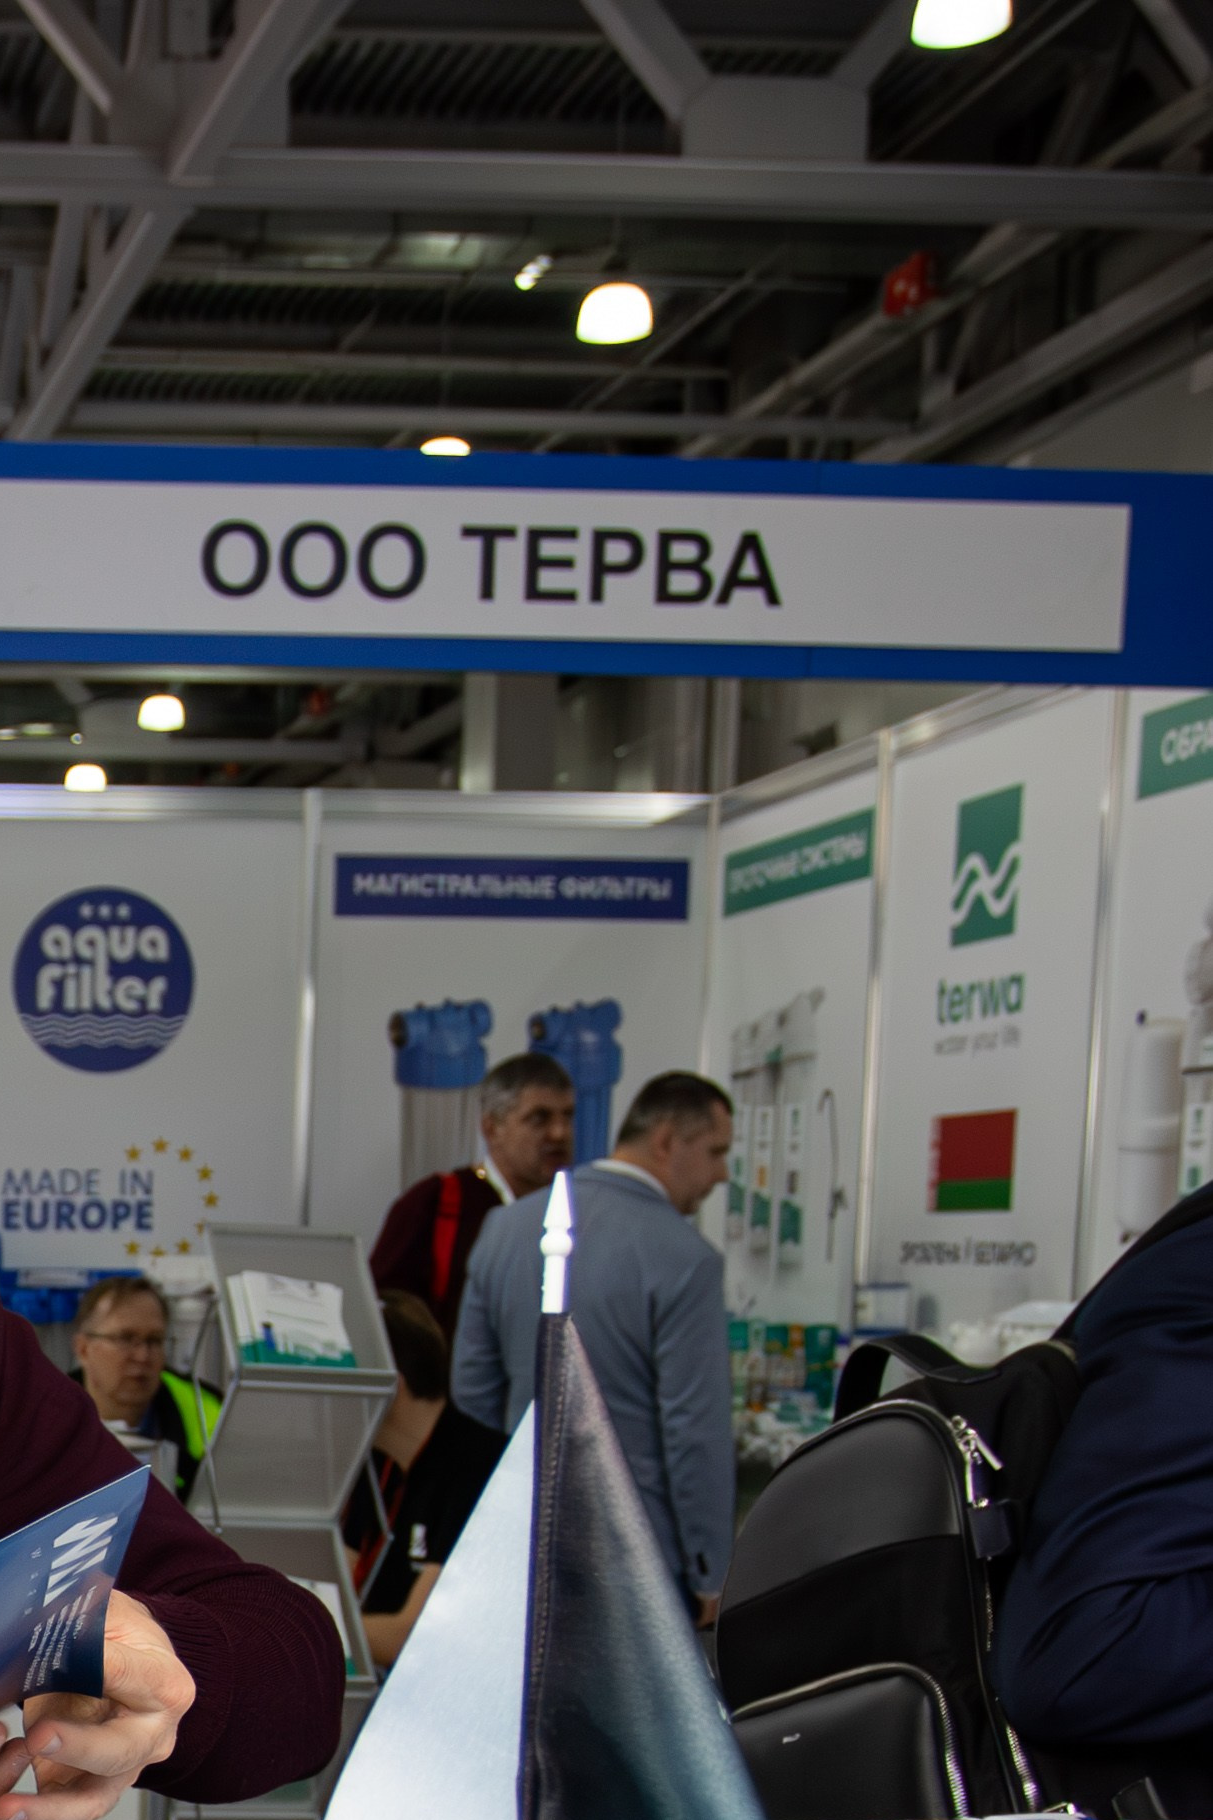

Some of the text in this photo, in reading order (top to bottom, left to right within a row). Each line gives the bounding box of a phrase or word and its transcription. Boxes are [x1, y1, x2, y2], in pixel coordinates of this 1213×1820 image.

[201, 519, 782, 606] ООО ТЕРВА
[801, 828, 868, 874] СИСТЕМЫ
[352, 872, 673, 900] МАГИСТРАЛЬНЫЕ ФИЛЬТРЫ
[40, 923, 171, 966] aqua
[937, 972, 1025, 1025] terwa
[1, 1167, 154, 1196] MADE IN
[1, 1199, 154, 1232] EUROPE
